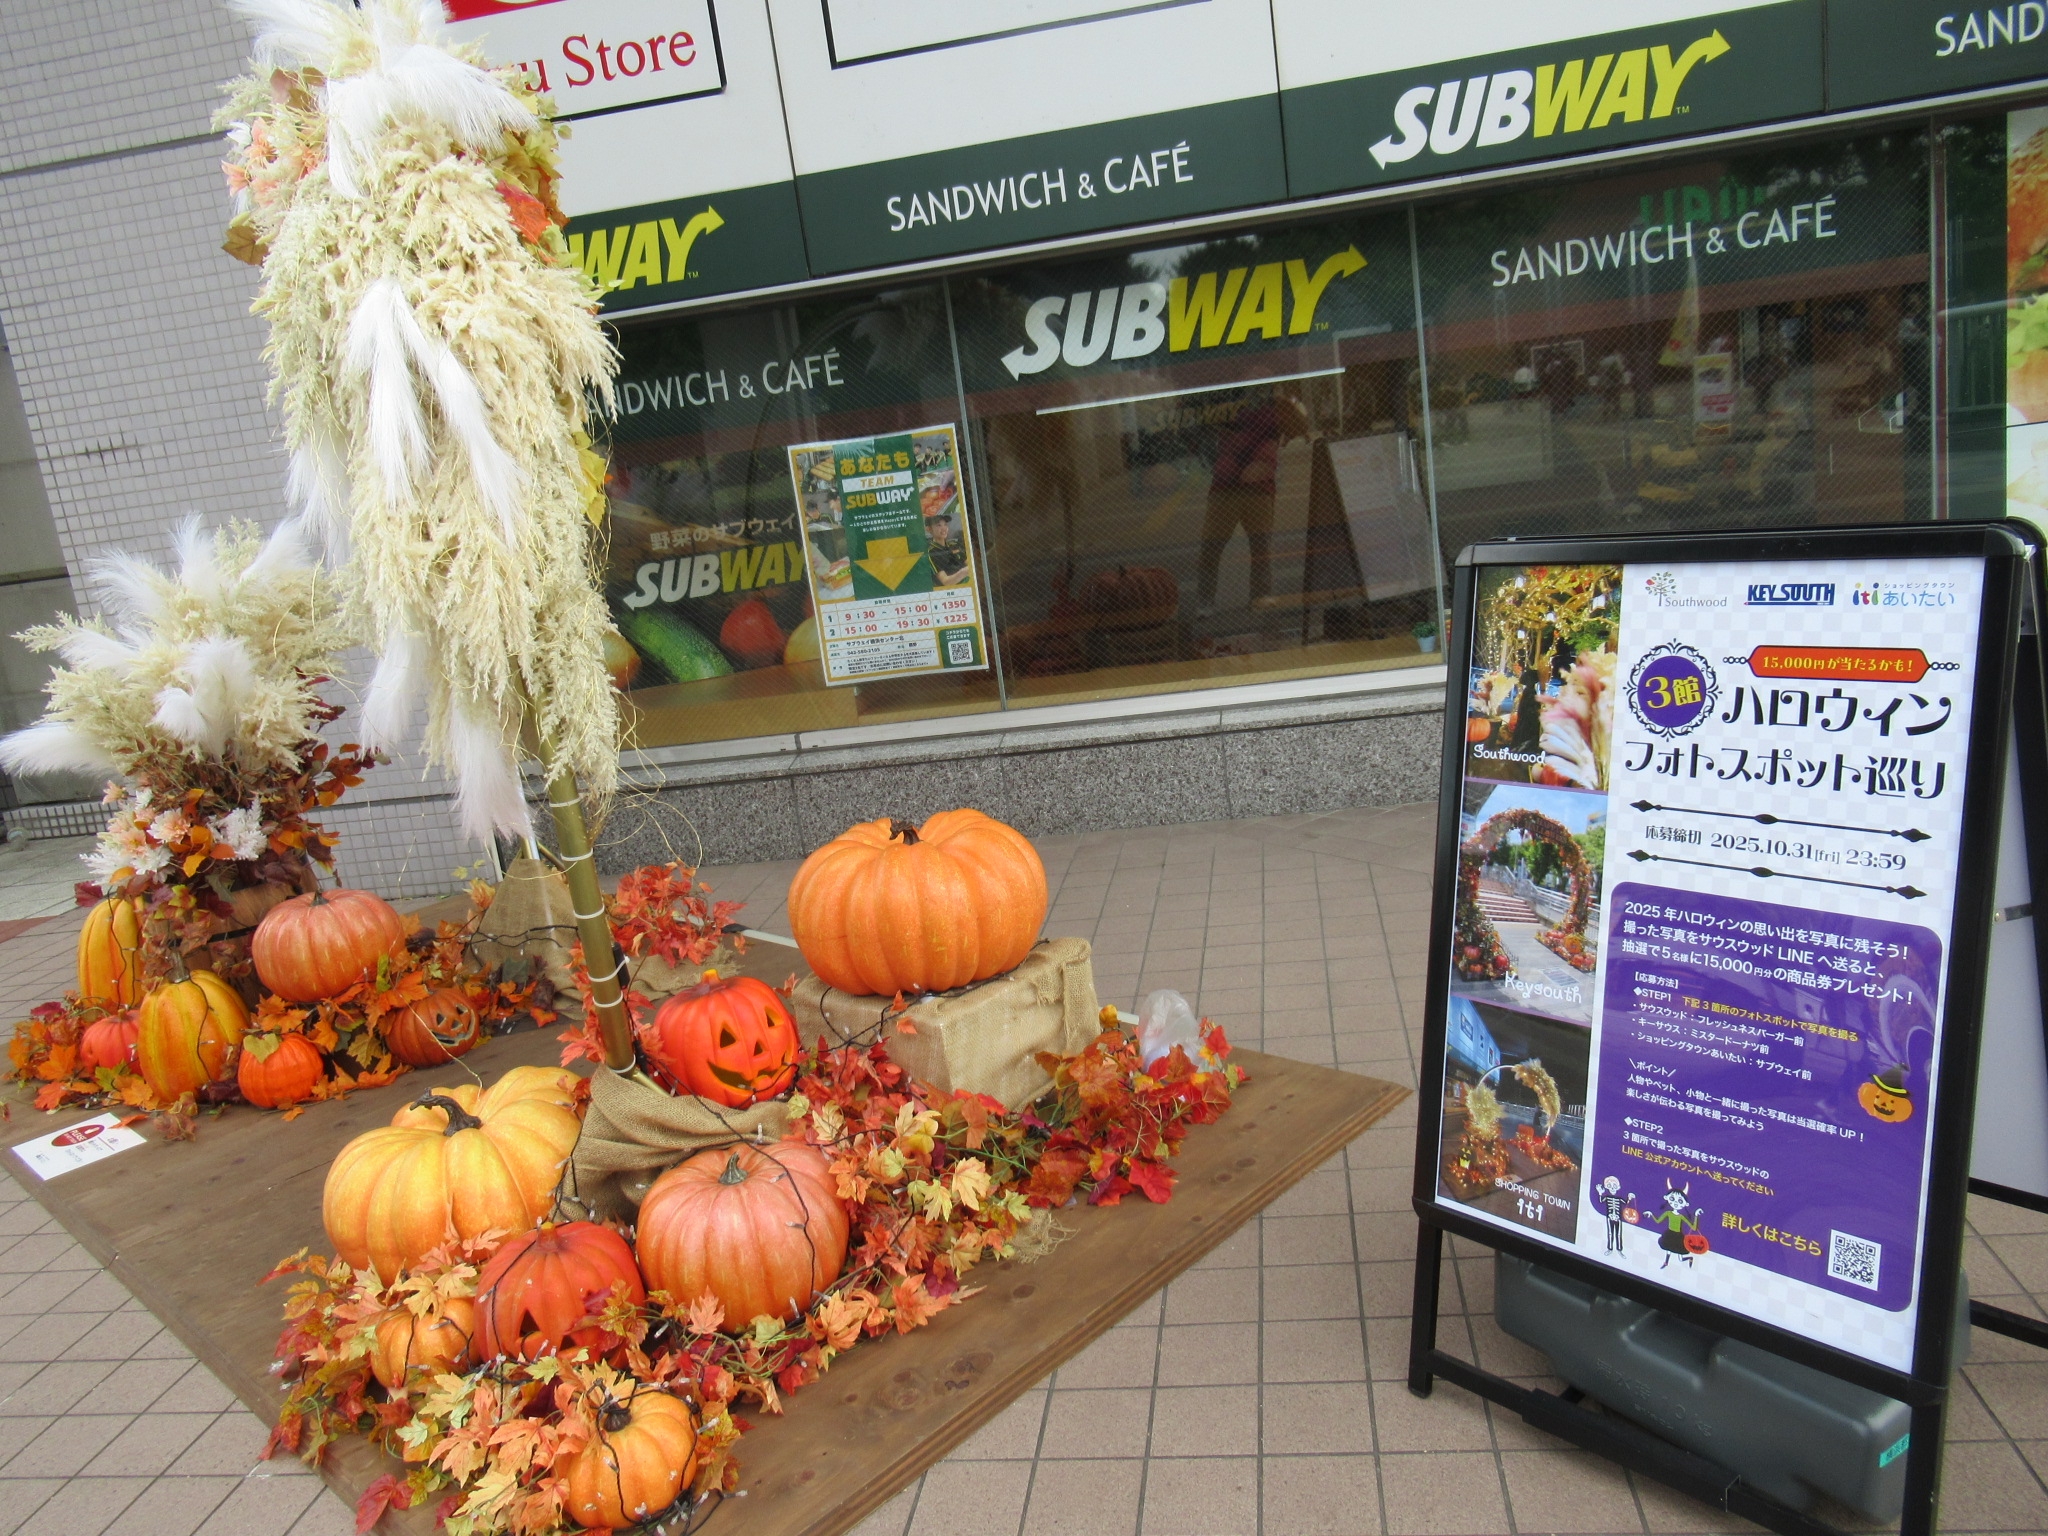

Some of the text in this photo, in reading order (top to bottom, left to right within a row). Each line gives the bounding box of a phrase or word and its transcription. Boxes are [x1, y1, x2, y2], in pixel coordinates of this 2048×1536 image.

[1935, 1, 2048, 56] SAND
[562, 31, 697, 88] Store
[1368, 28, 1731, 170] SUBWAY
[886, 140, 1194, 232] SANDWICH & CAFÉ
[566, 205, 725, 293] WAY
[1490, 221, 1692, 288] SANDWICH
[1705, 227, 1726, 254] &
[1737, 194, 1836, 249] CAFÉ
[1000, 243, 1369, 382] SUBWAY
[585, 347, 844, 418] ANDWICH & CAFÉ
[840, 451, 910, 476] あなたも
[860, 475, 895, 488] TEAM
[845, 487, 915, 510] SUBWAY
[650, 512, 796, 550] 野菜のサブウェイ
[827, 615, 833, 623] 1
[941, 600, 967, 610] 1350
[1665, 596, 1727, 607] Southwood
[1747, 583, 1836, 605] KEY SOUTH
[1882, 590, 1955, 607] あいたい
[944, 613, 968, 623] 1225
[1762, 655, 1914, 673] 15,000円が当たるかも！
[1645, 675, 1702, 710] 3館
[1722, 685, 1952, 737] ハロウィン
[1473, 743, 1546, 764] Southwood
[1625, 741, 1946, 800] フォトスポット巡り
[1645, 825, 1702, 845] 応募締切
[1845, 848, 1907, 871] 23:59
[1504, 970, 1582, 1004] Keysouth
[1626, 1087, 1765, 1131] 楽しさが伝わる写真を撮ってみよう
[1494, 1177, 1571, 1211] SHOPPING TOWN
[1721, 1211, 1823, 1257] 詳しくはこちら
